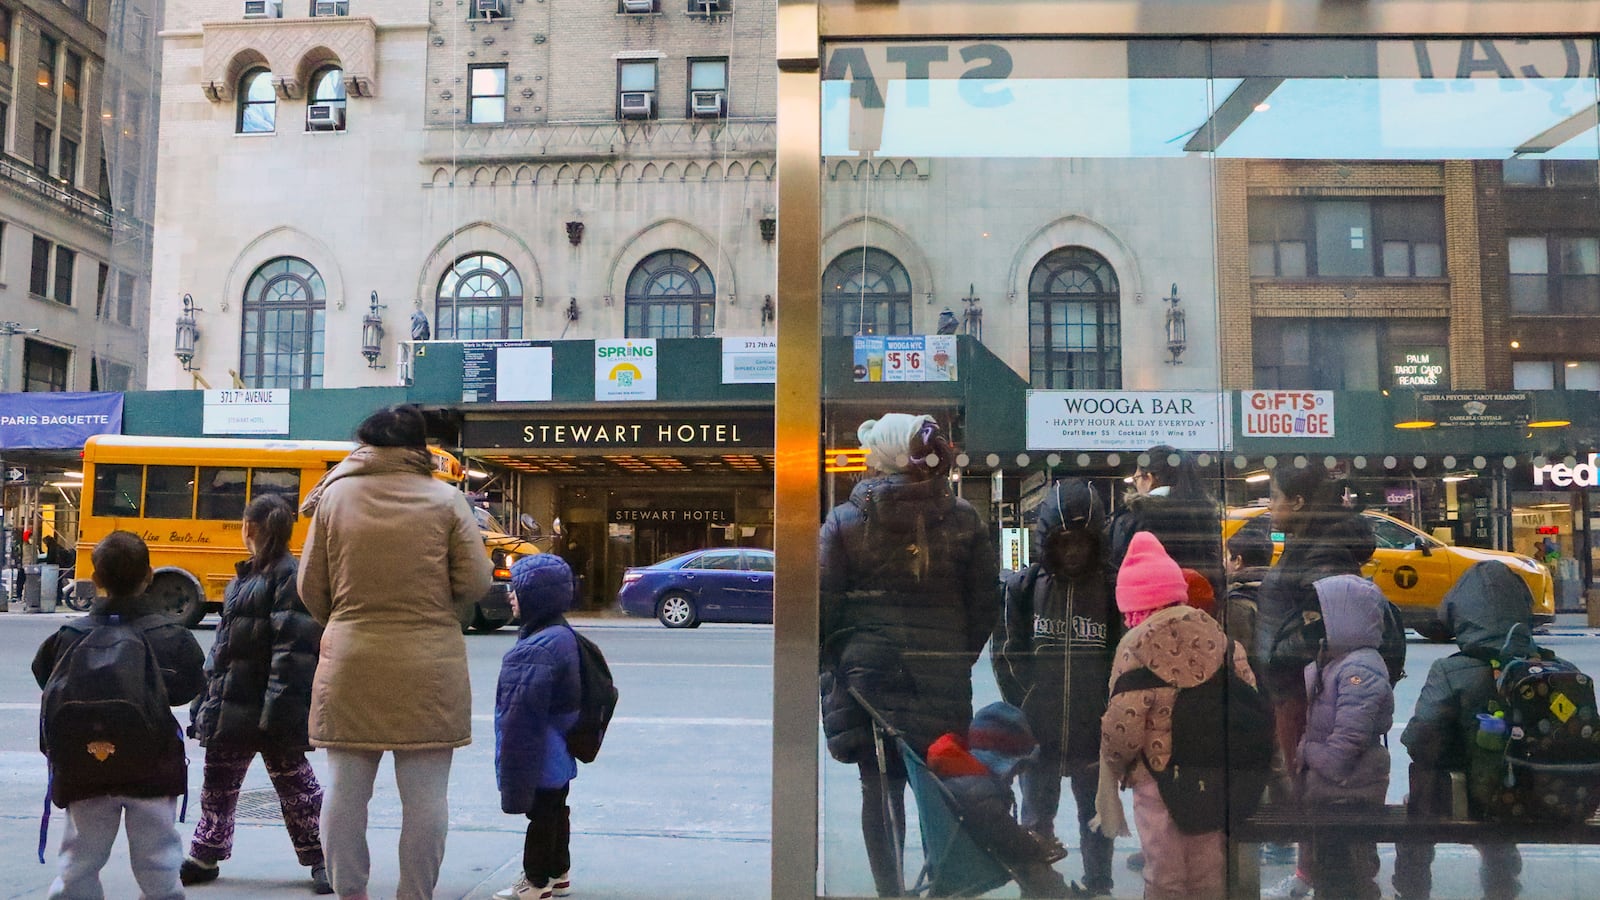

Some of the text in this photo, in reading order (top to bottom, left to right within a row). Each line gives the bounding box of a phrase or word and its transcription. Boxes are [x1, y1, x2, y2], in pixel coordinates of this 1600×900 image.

[598, 341, 654, 358] SPRING
[887, 352, 920, 370] $5 $6
[1406, 354, 1430, 364] PALM
[1394, 365, 1442, 375] TAROT CARD
[1399, 376, 1438, 385] READINGS
[220, 391, 233, 403] 371
[245, 391, 273, 403] AVENUE
[1494, 393, 1526, 401] READINGS
[1063, 398, 1196, 415] WOOGA BAR
[1, 415, 109, 425] PARIS BAGUETTE
[1053, 418, 1085, 427] HAPPY
[1088, 418, 1116, 427] HOUR
[1119, 419, 1135, 427] ALL
[1137, 419, 1156, 427] DAY
[523, 425, 741, 443] STEWART HOTEL
[615, 510, 726, 520] STEWART HOTEL
